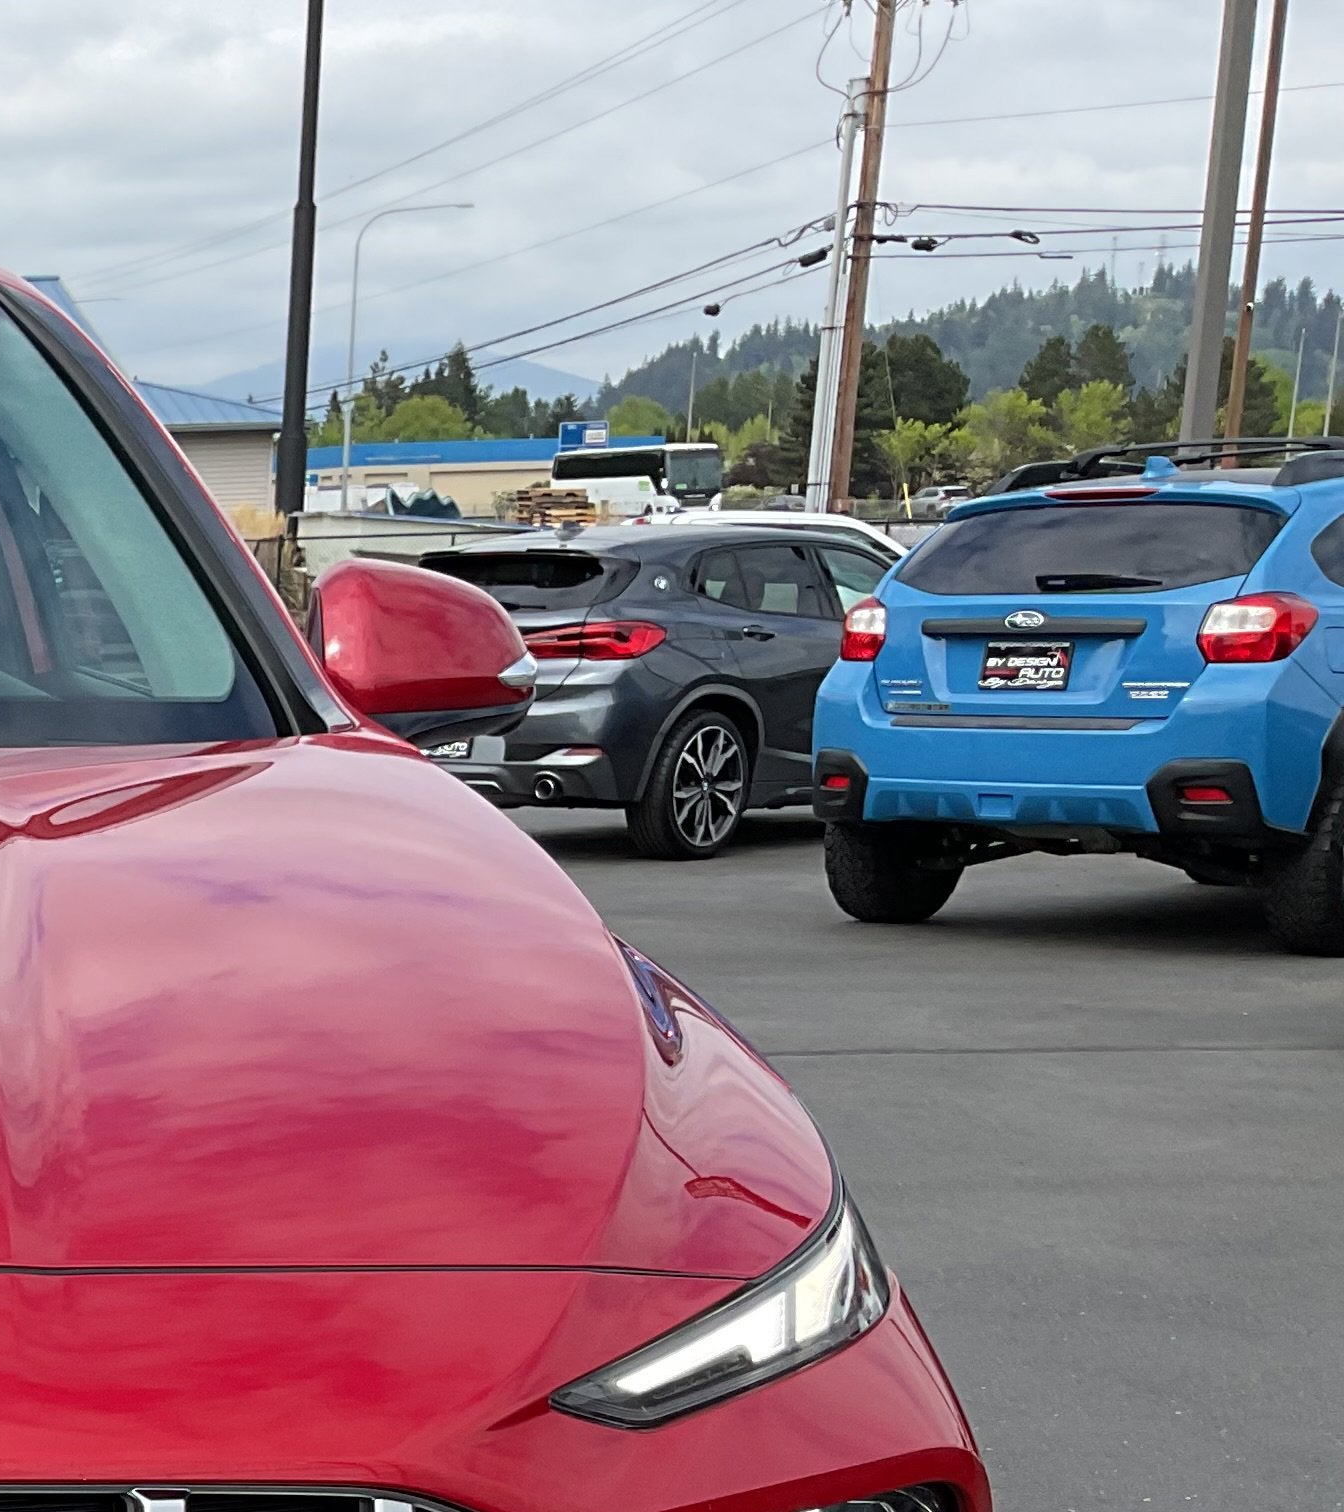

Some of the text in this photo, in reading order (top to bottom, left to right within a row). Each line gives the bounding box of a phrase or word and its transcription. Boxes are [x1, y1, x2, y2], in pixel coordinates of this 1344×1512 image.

[986, 657, 1058, 667] BY DESIGN
[1018, 668, 1064, 678] AUTO
